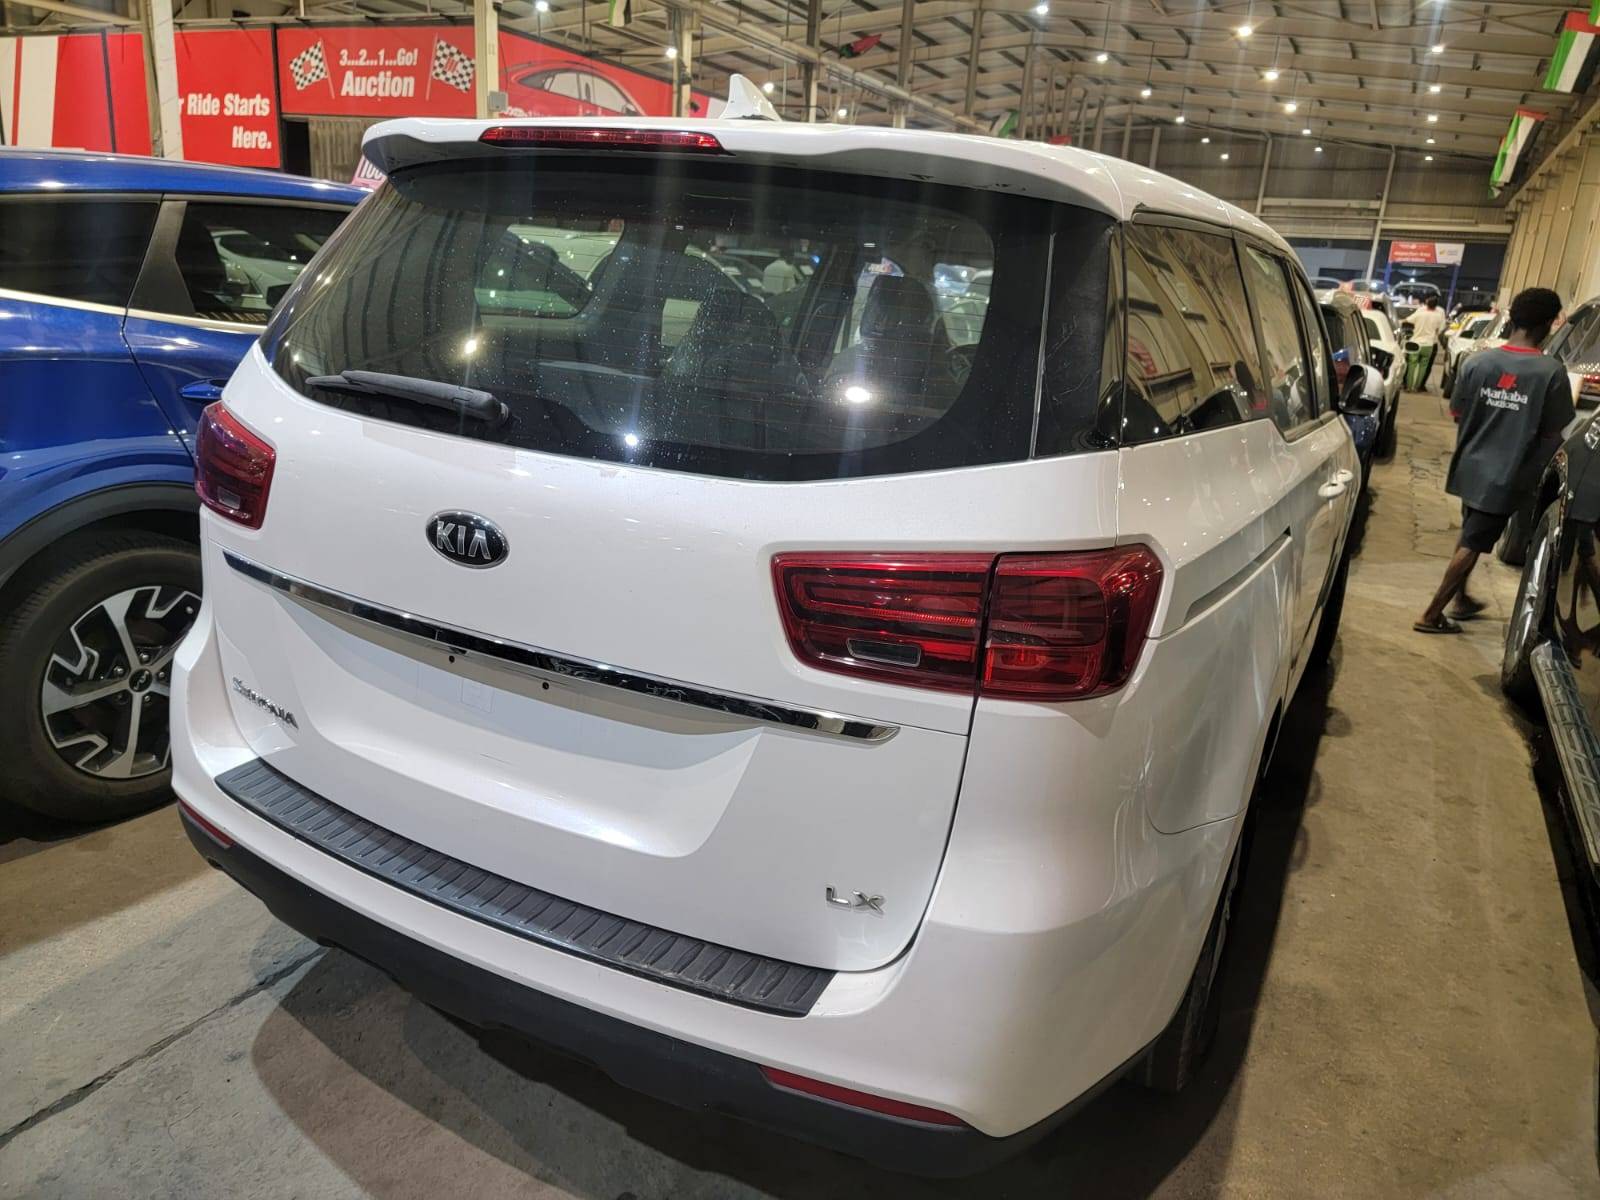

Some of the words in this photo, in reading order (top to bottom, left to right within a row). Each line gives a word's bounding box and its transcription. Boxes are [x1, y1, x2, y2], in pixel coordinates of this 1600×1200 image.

[339, 48, 418, 66] 3...2...1...Go!
[341, 70, 415, 98] Auction
[187, 93, 220, 116] Ride
[223, 93, 270, 117] Starts
[232, 126, 272, 149] Here.
[1480, 387, 1528, 405] Marhaba
[436, 520, 492, 560] KIA
[825, 886, 885, 916] LX
